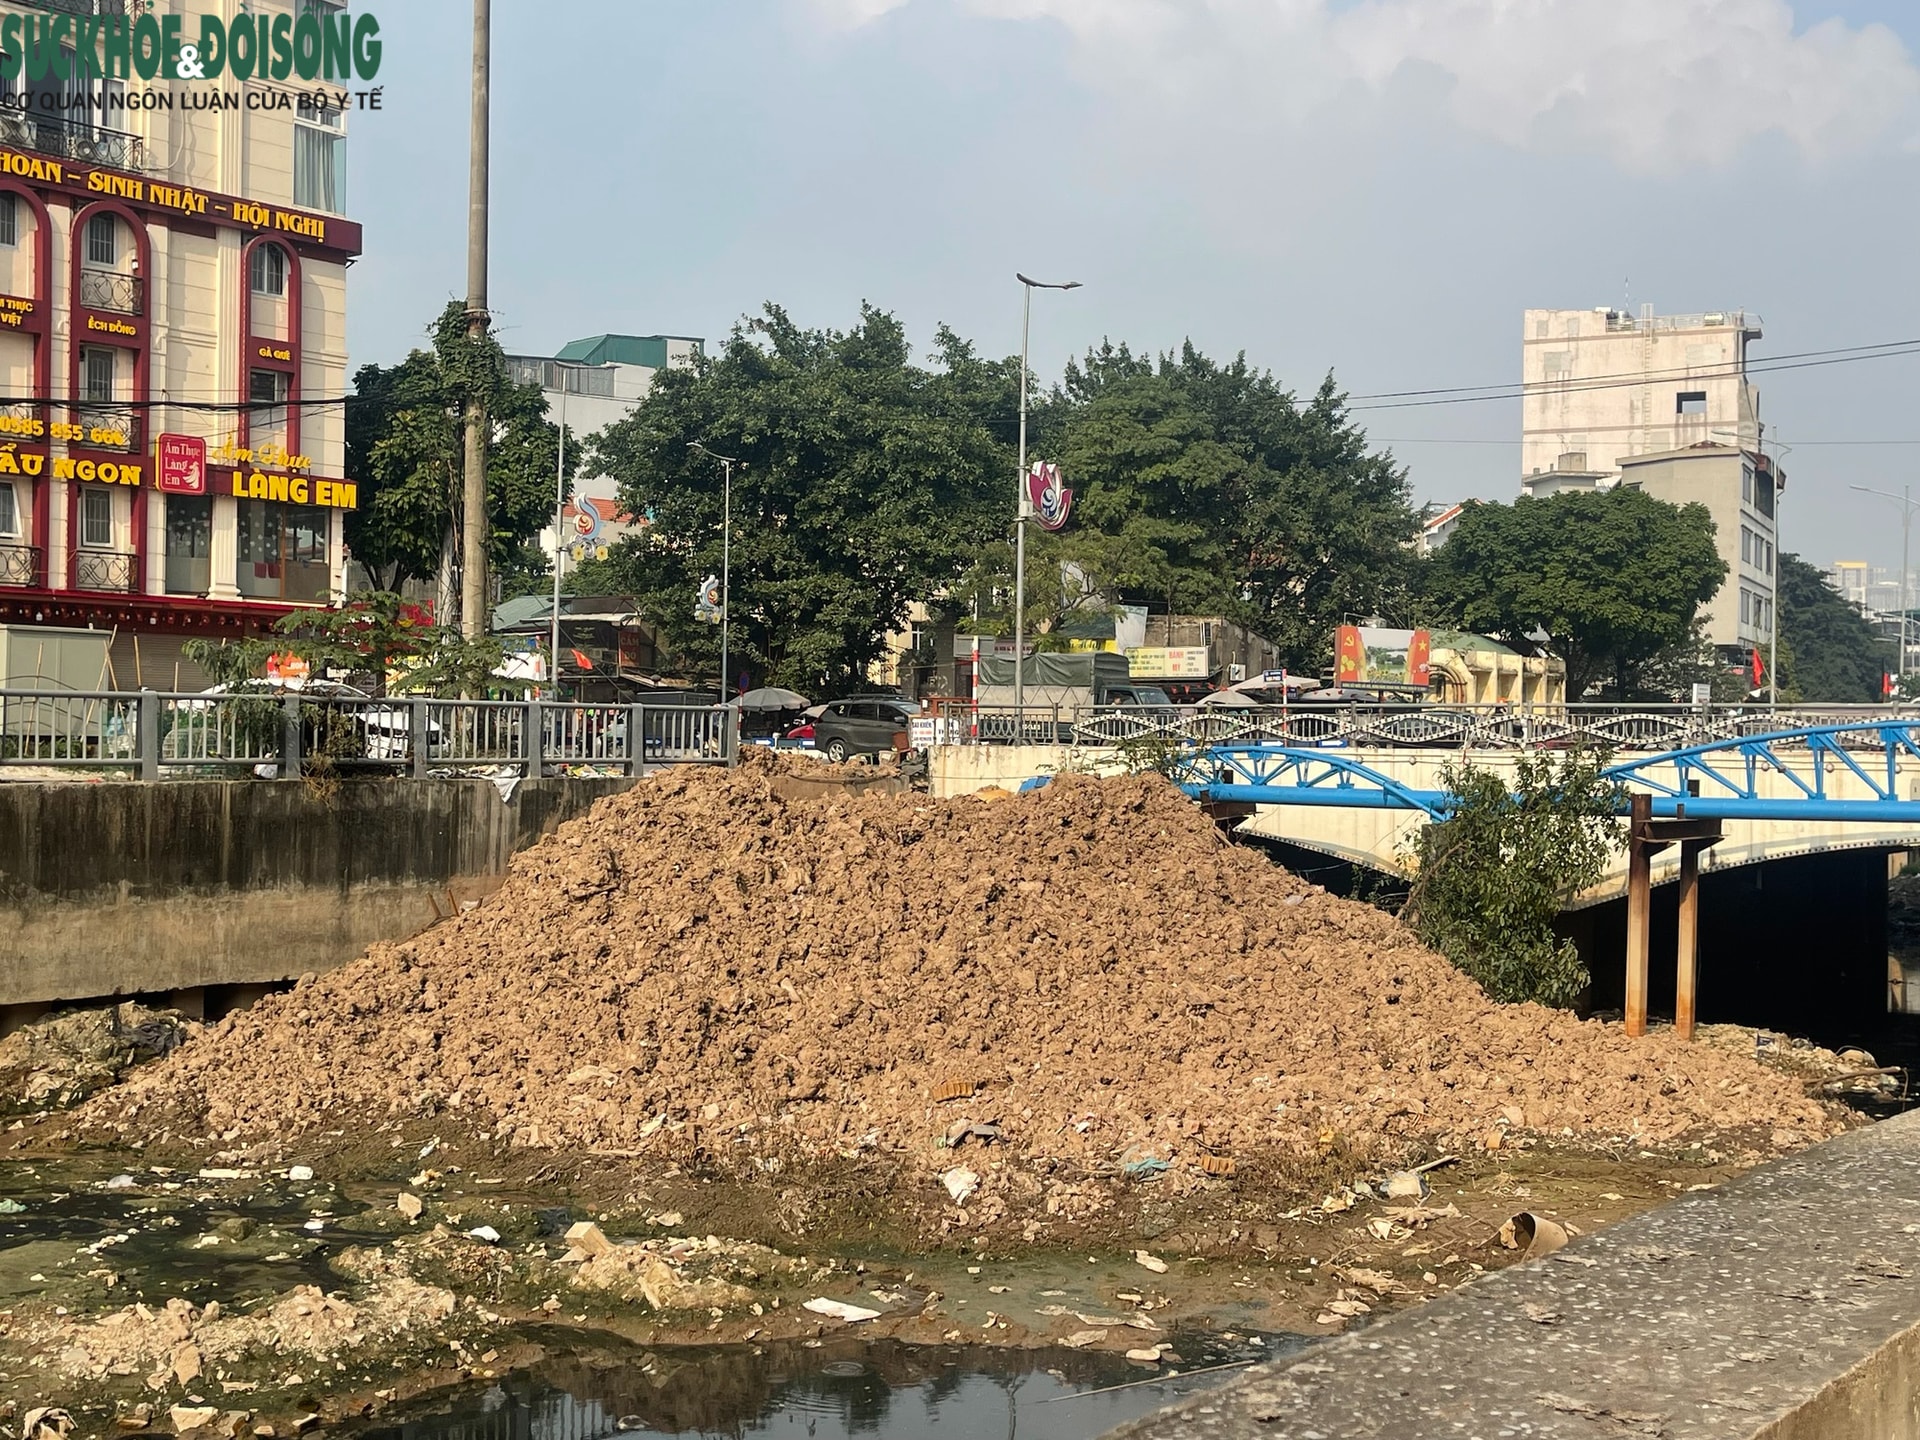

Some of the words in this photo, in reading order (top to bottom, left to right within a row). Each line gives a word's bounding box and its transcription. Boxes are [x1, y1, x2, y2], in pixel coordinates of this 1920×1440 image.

[88, 171, 143, 200] SINH
[150, 185, 209, 216] NHẬT
[233, 202, 270, 229] HỘI
[275, 212, 325, 243] NGHỊ
[6, 299, 33, 315] THỰC
[1, 312, 22, 327] VIỆT
[259, 346, 272, 358] GÀ
[180, 443, 200, 458] Thực
[53, 457, 141, 485] NGON
[165, 457, 188, 473] Làng
[165, 473, 180, 485] Em
[232, 468, 308, 503] LÀNG
[316, 480, 356, 508] EM
